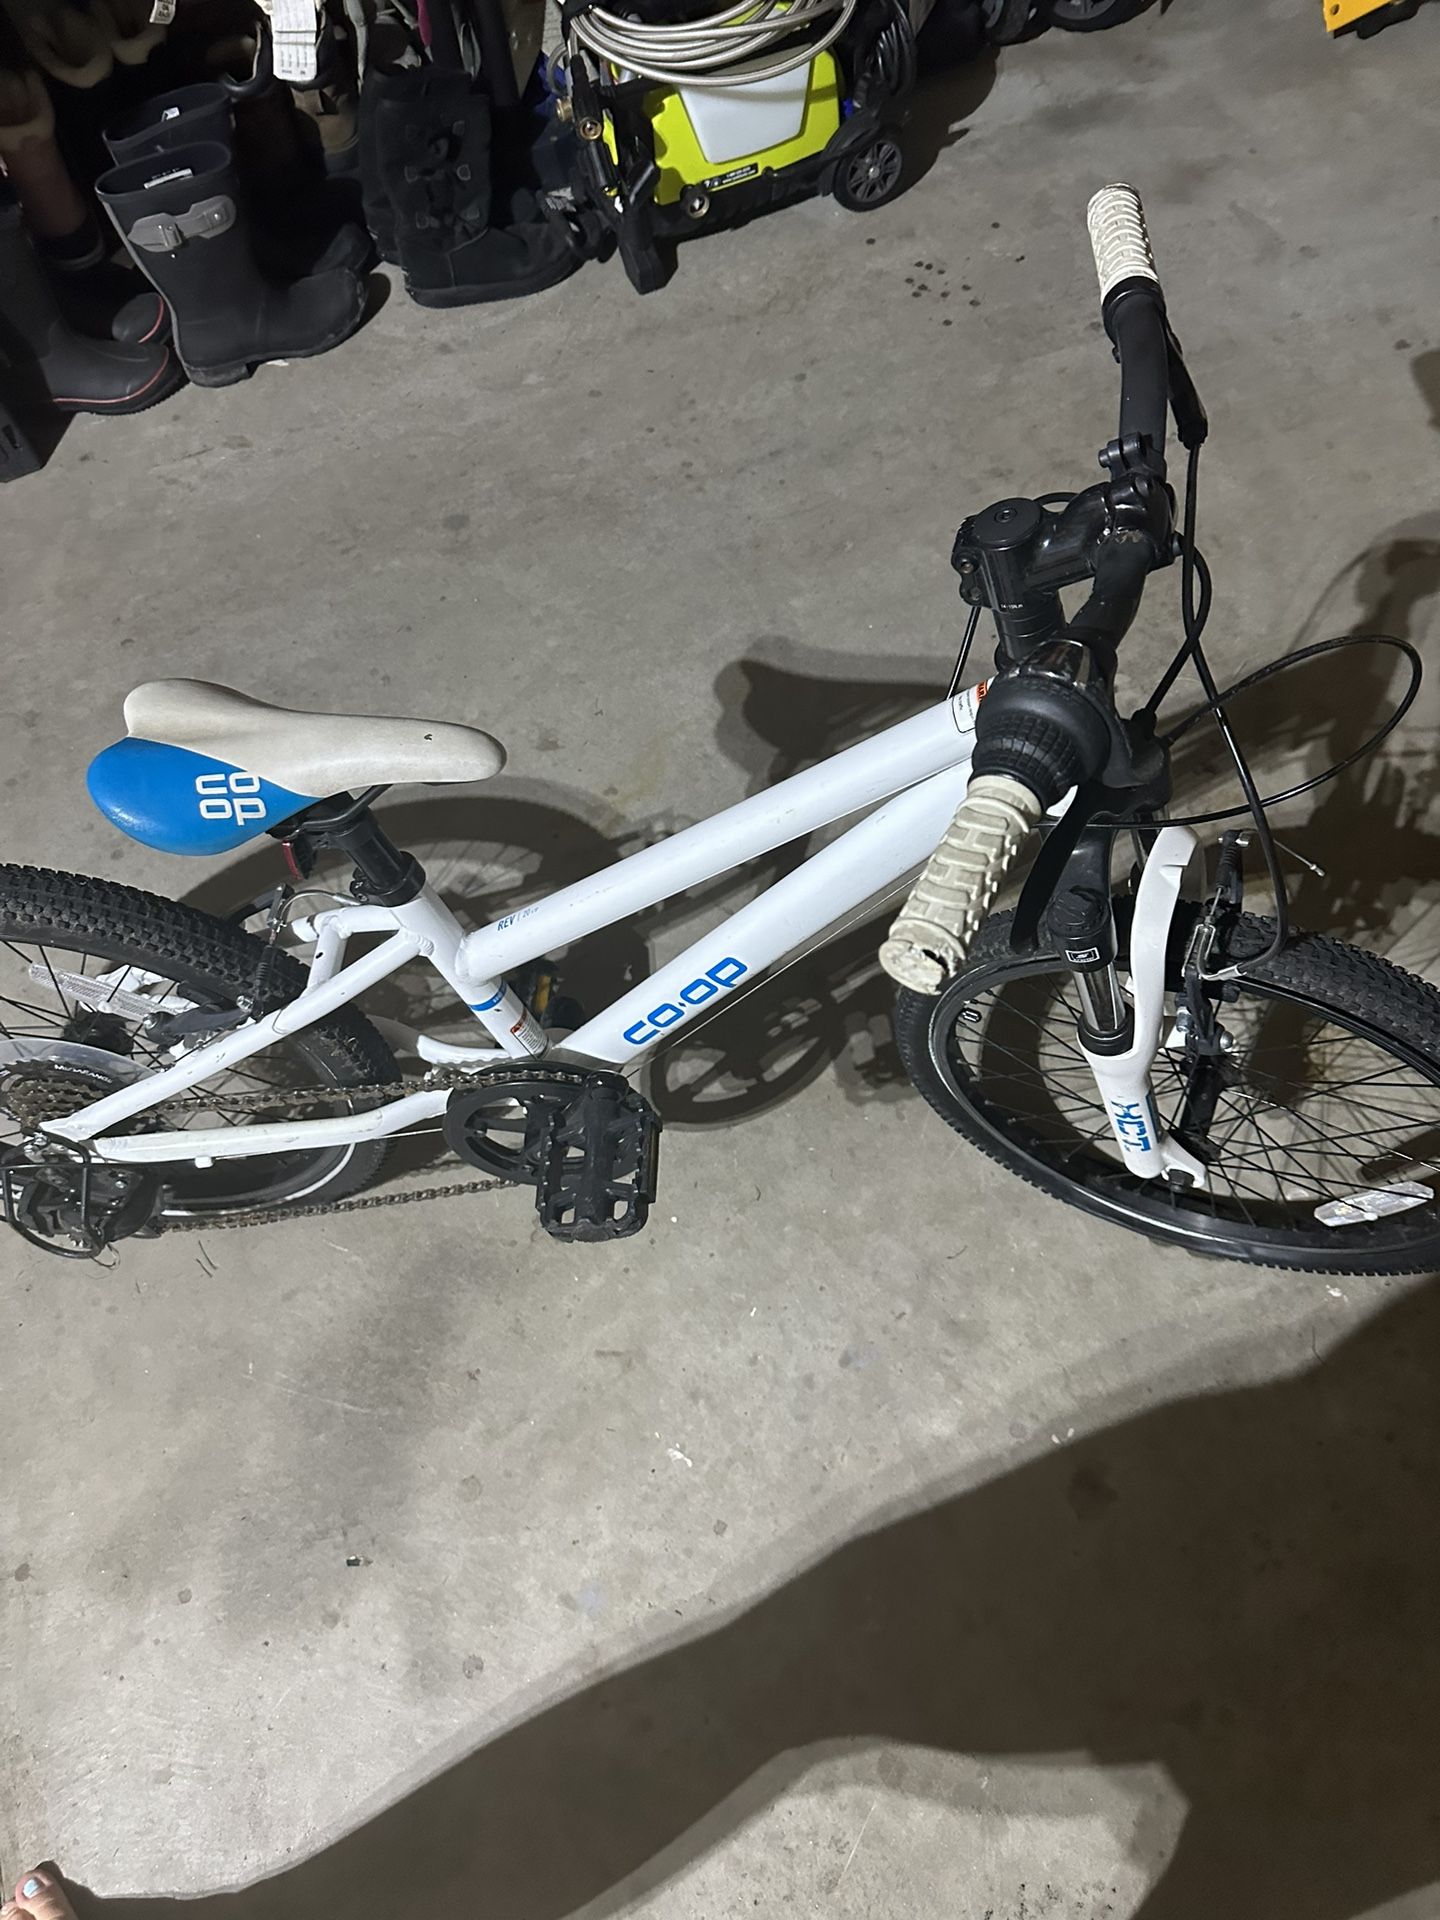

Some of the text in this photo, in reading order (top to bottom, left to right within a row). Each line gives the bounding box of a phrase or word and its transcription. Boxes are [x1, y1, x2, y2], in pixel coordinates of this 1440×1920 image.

[195, 772, 261, 795] CO
[199, 797, 267, 826] OP
[497, 914, 516, 931] REV
[1110, 1100, 1151, 1152] XCT
